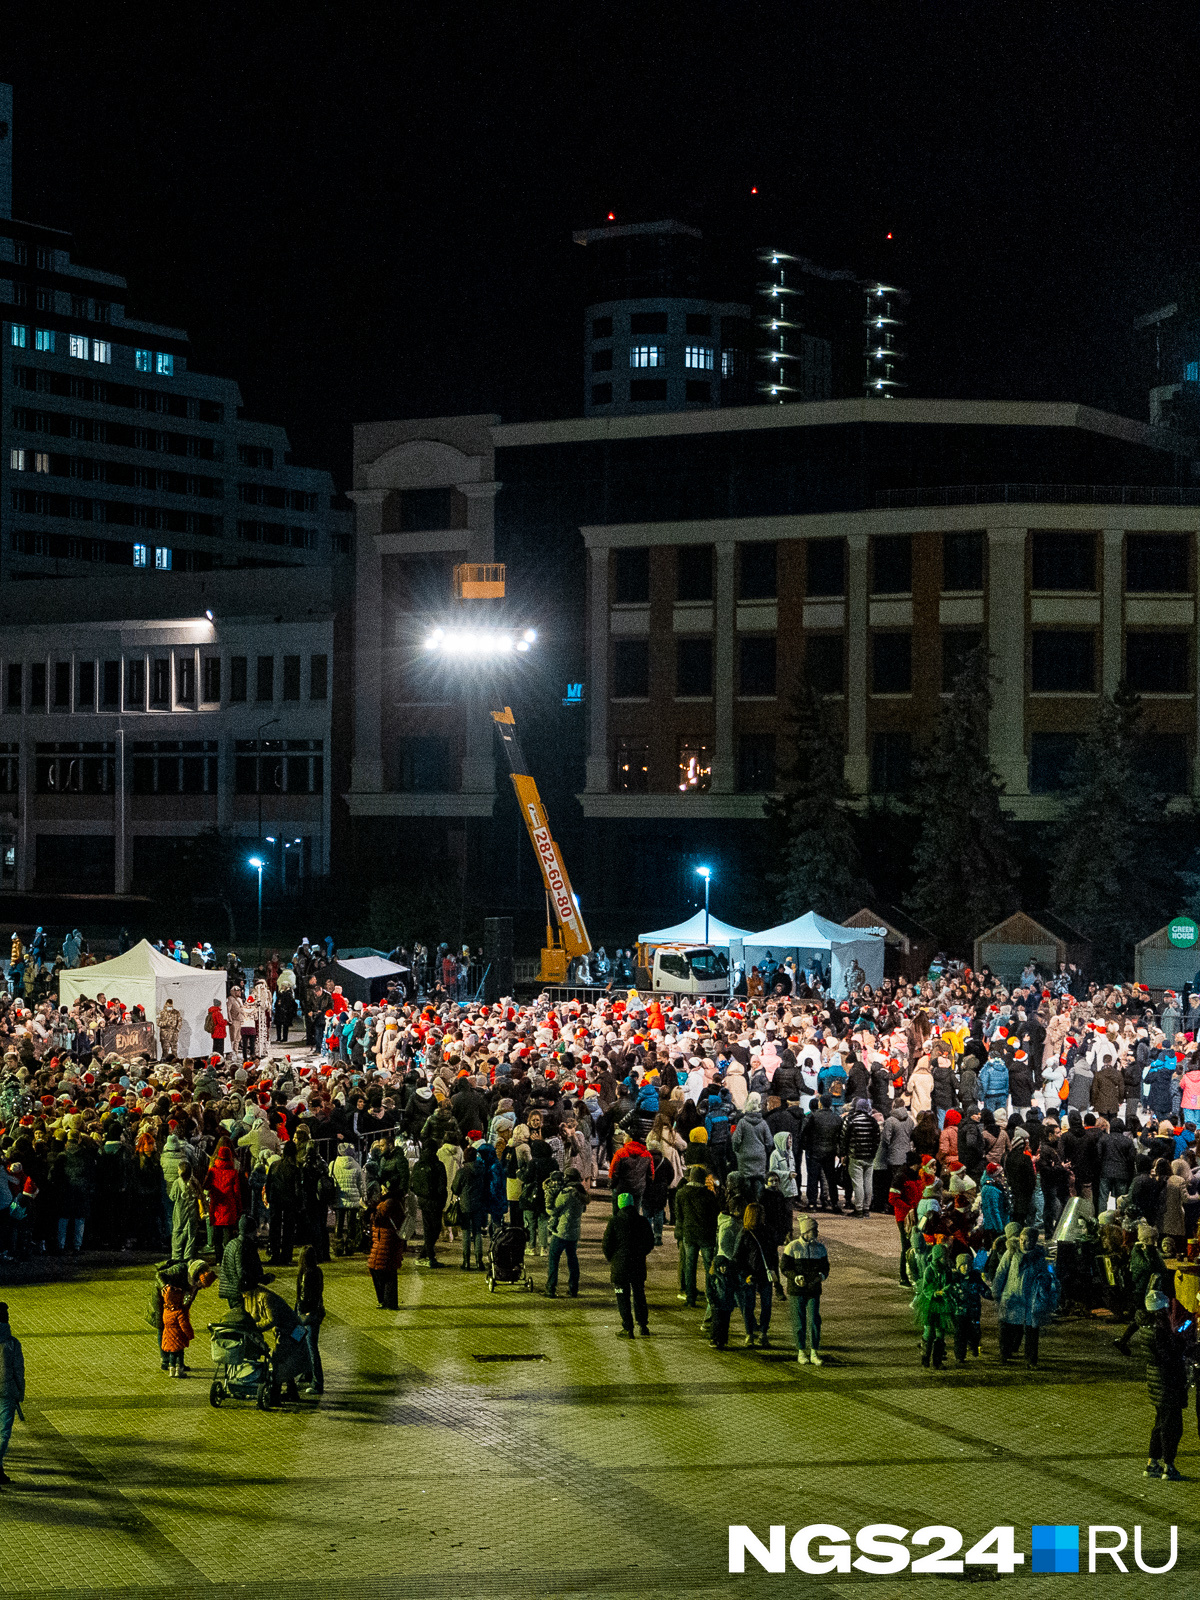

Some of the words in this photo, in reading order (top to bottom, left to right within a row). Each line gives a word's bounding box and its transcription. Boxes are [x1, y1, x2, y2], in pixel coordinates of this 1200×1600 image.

[535, 831, 573, 918] 282-60-80
[1171, 925, 1195, 933] GREEN
[1171, 932, 1195, 940] HOUSE
